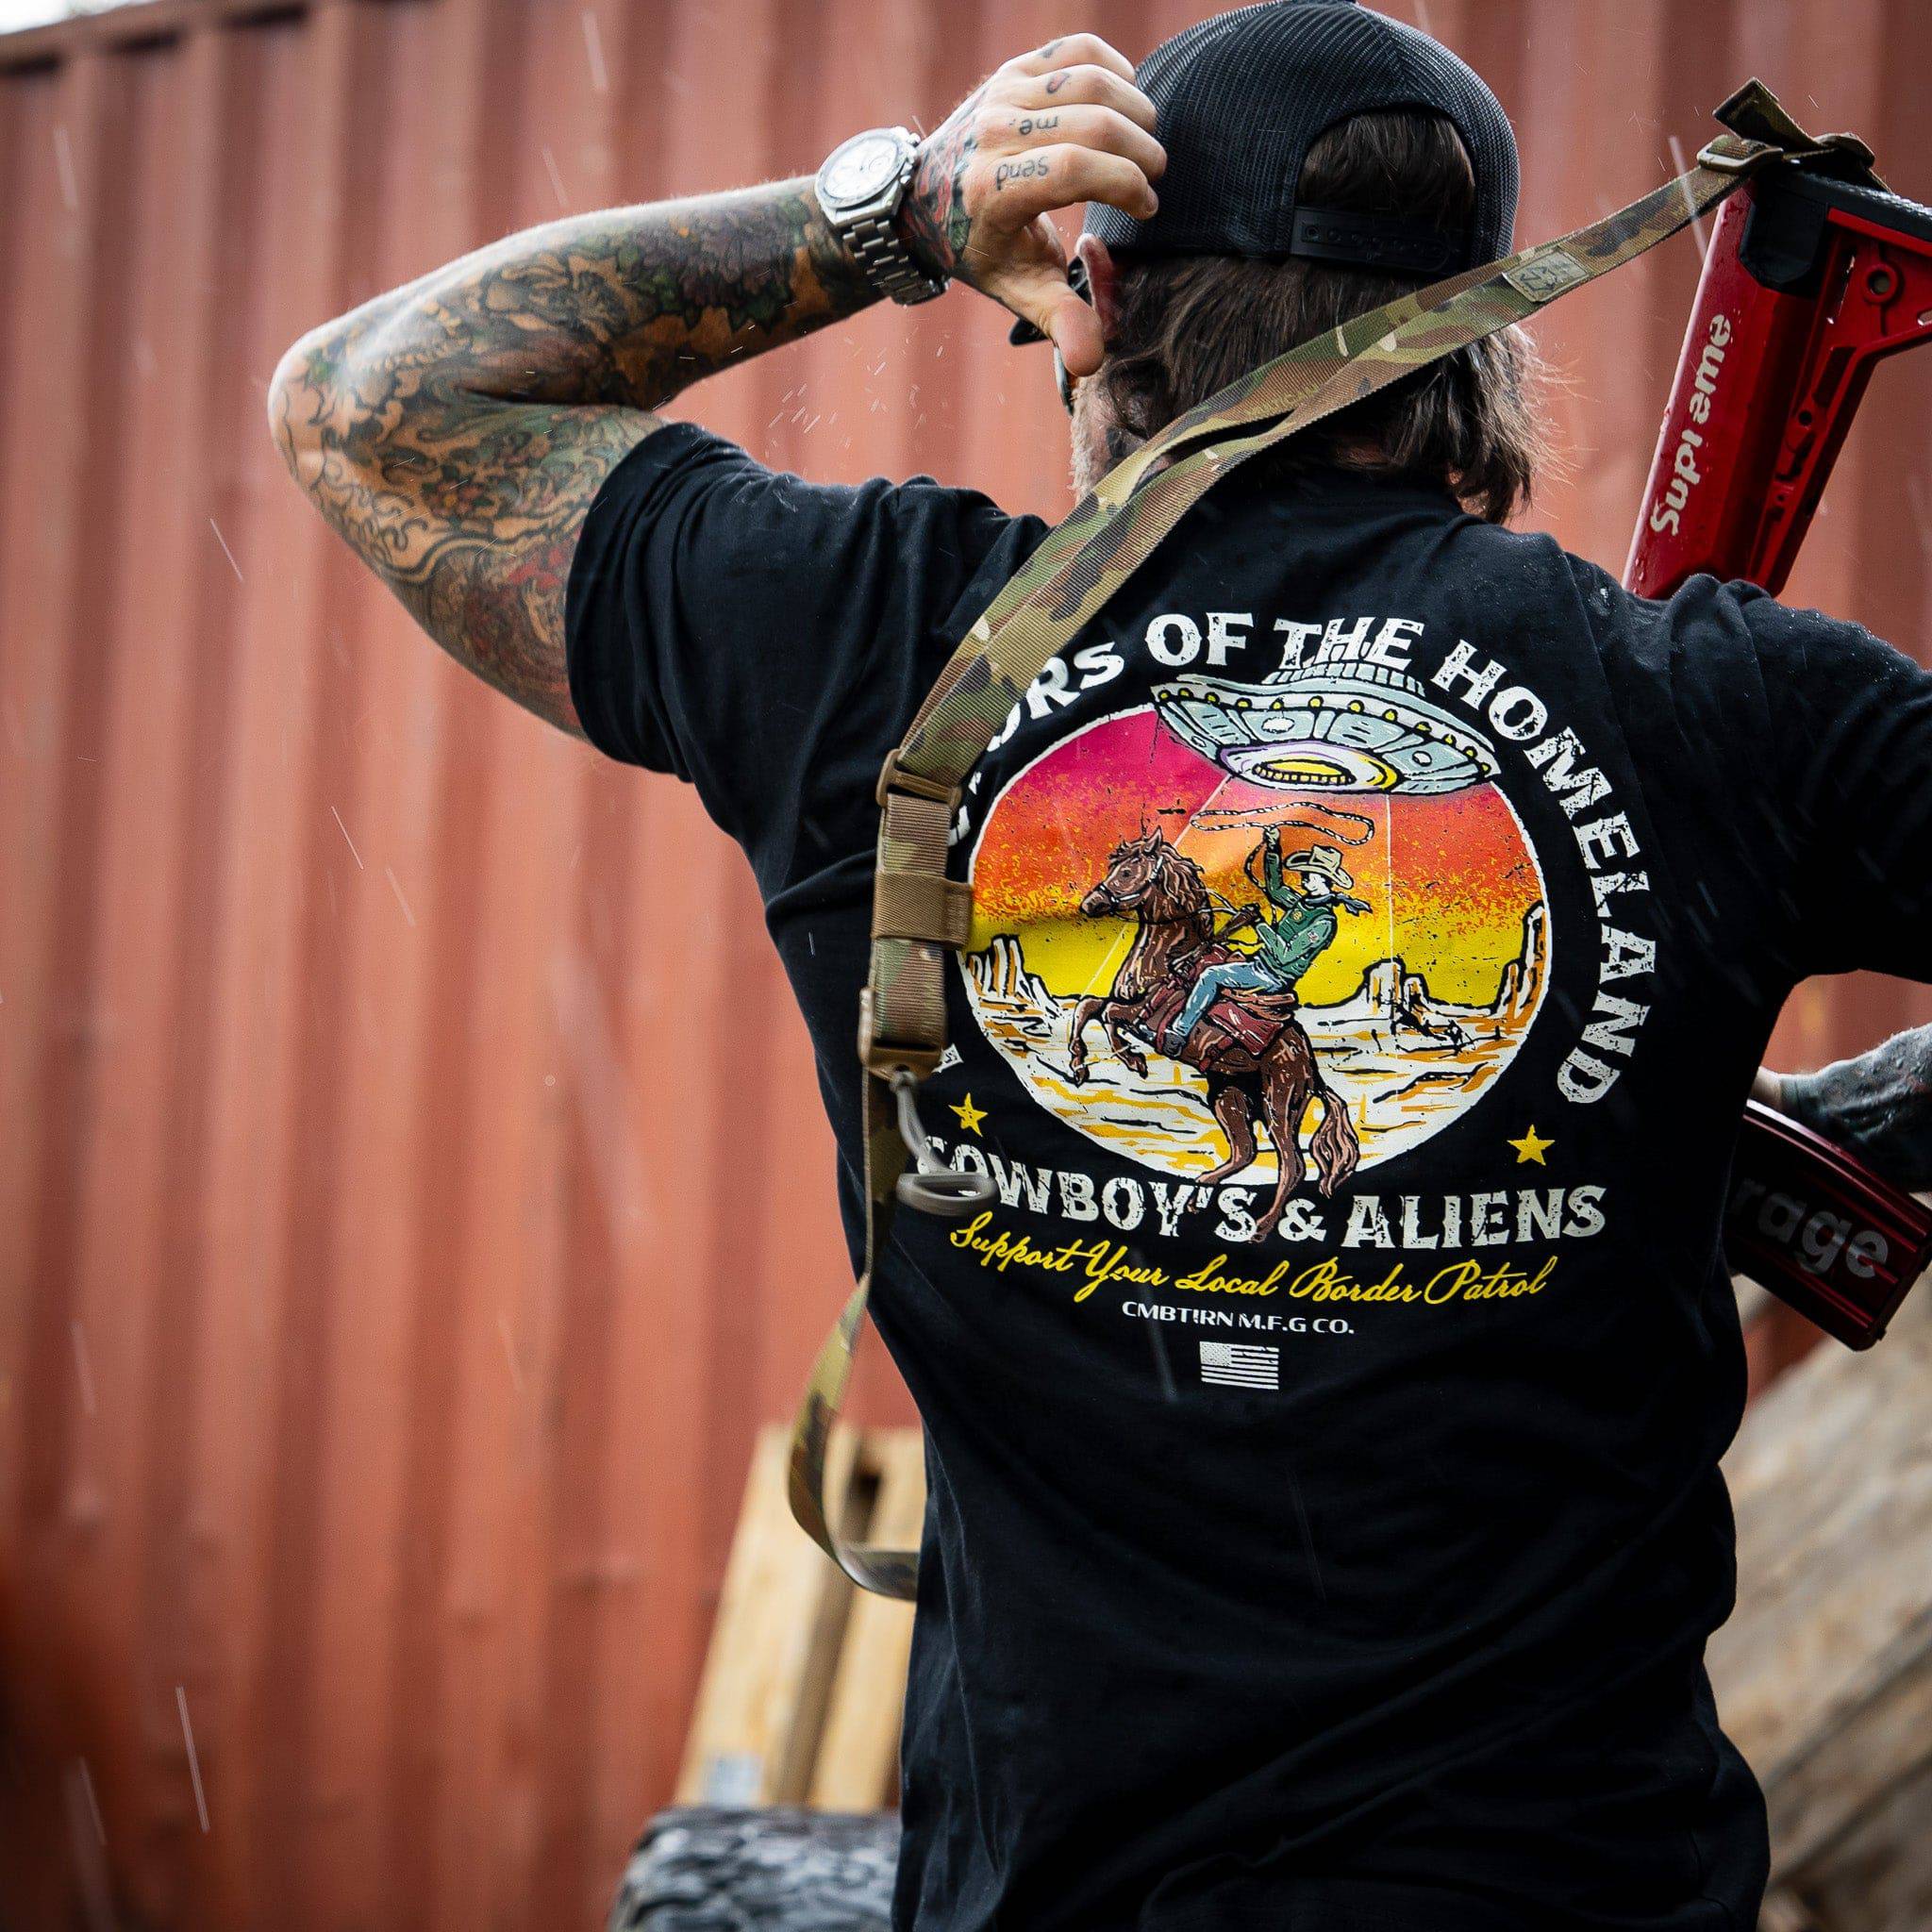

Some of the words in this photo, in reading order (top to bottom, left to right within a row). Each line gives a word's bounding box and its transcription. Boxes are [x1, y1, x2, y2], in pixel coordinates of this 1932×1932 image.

[996, 157, 1050, 191] send
[1144, 612, 1254, 666] OF
[1274, 617, 1424, 671] THE
[1430, 640, 1657, 1105] HOMELAND
[1277, 1198, 1326, 1241] &
[1341, 1185, 1607, 1249] ALIENS
[950, 1210, 1074, 1272] Support
[1074, 1240, 1170, 1303] Your
[1174, 1254, 1290, 1296] Local
[1289, 1257, 1422, 1303] Border
[1424, 1255, 1558, 1305] Patrol
[1312, 1318, 1355, 1334] CO.
